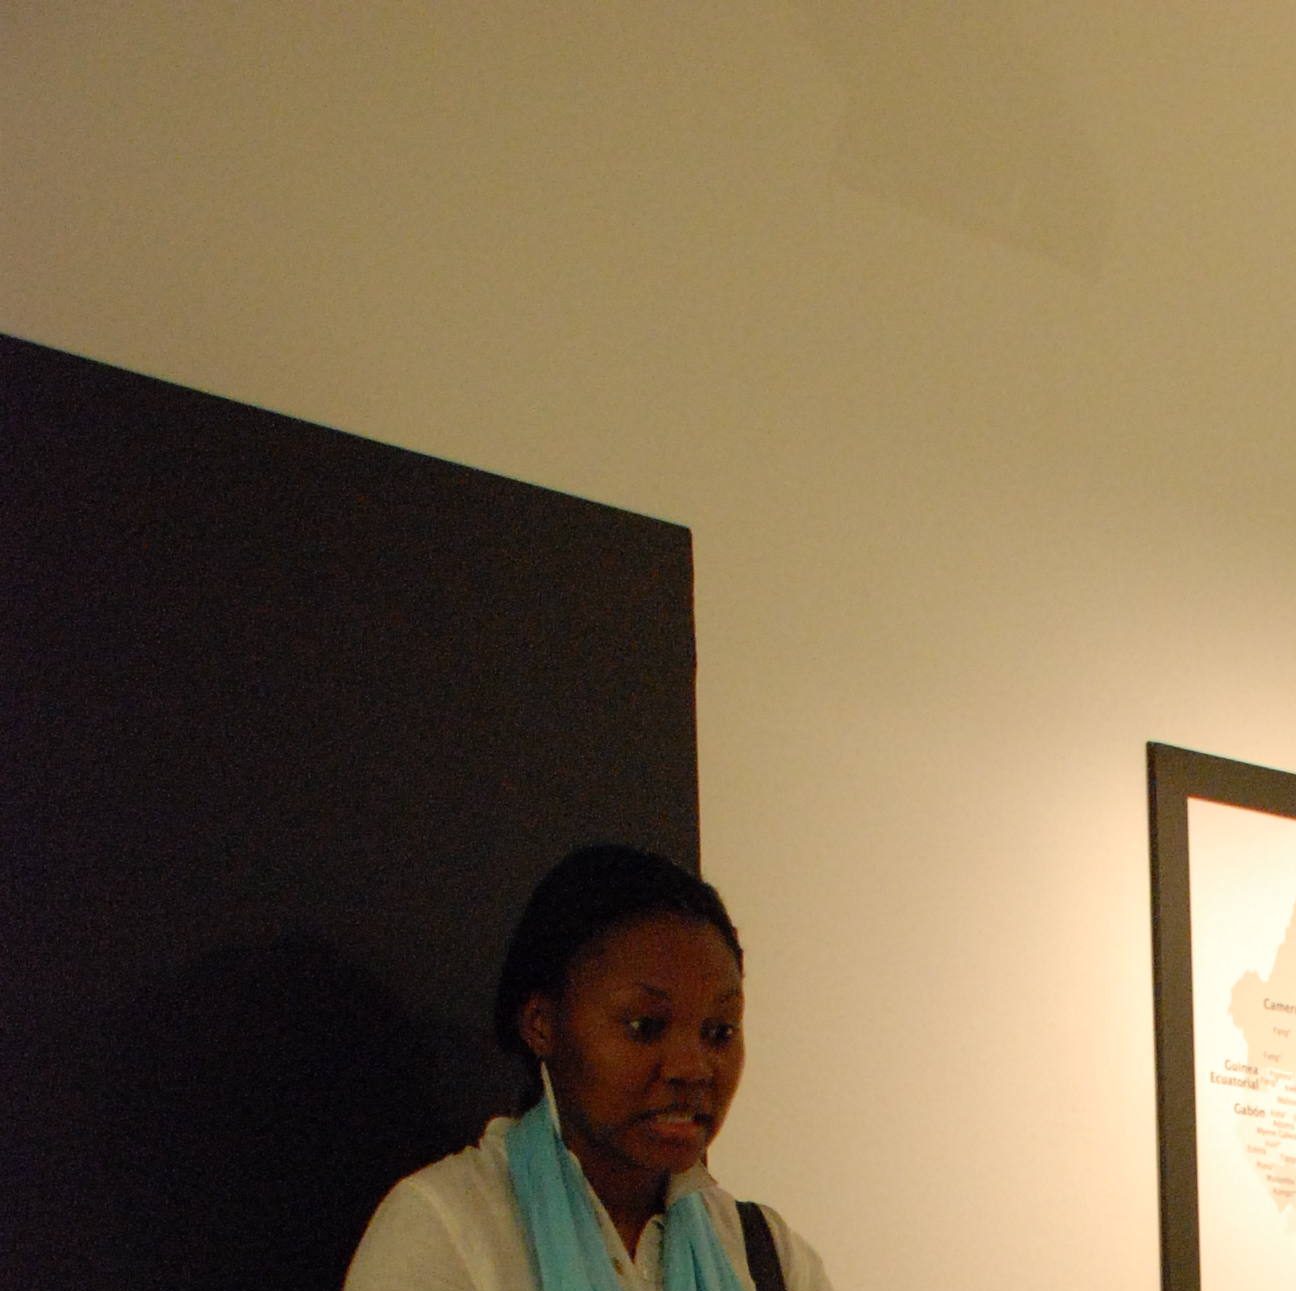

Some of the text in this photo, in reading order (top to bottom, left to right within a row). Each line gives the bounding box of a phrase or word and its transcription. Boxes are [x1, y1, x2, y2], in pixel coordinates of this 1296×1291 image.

[1224, 1058, 1259, 1076] Guinea
[1209, 1071, 1260, 1091] Ecuatorial
[1233, 1102, 1266, 1118] Gabón
